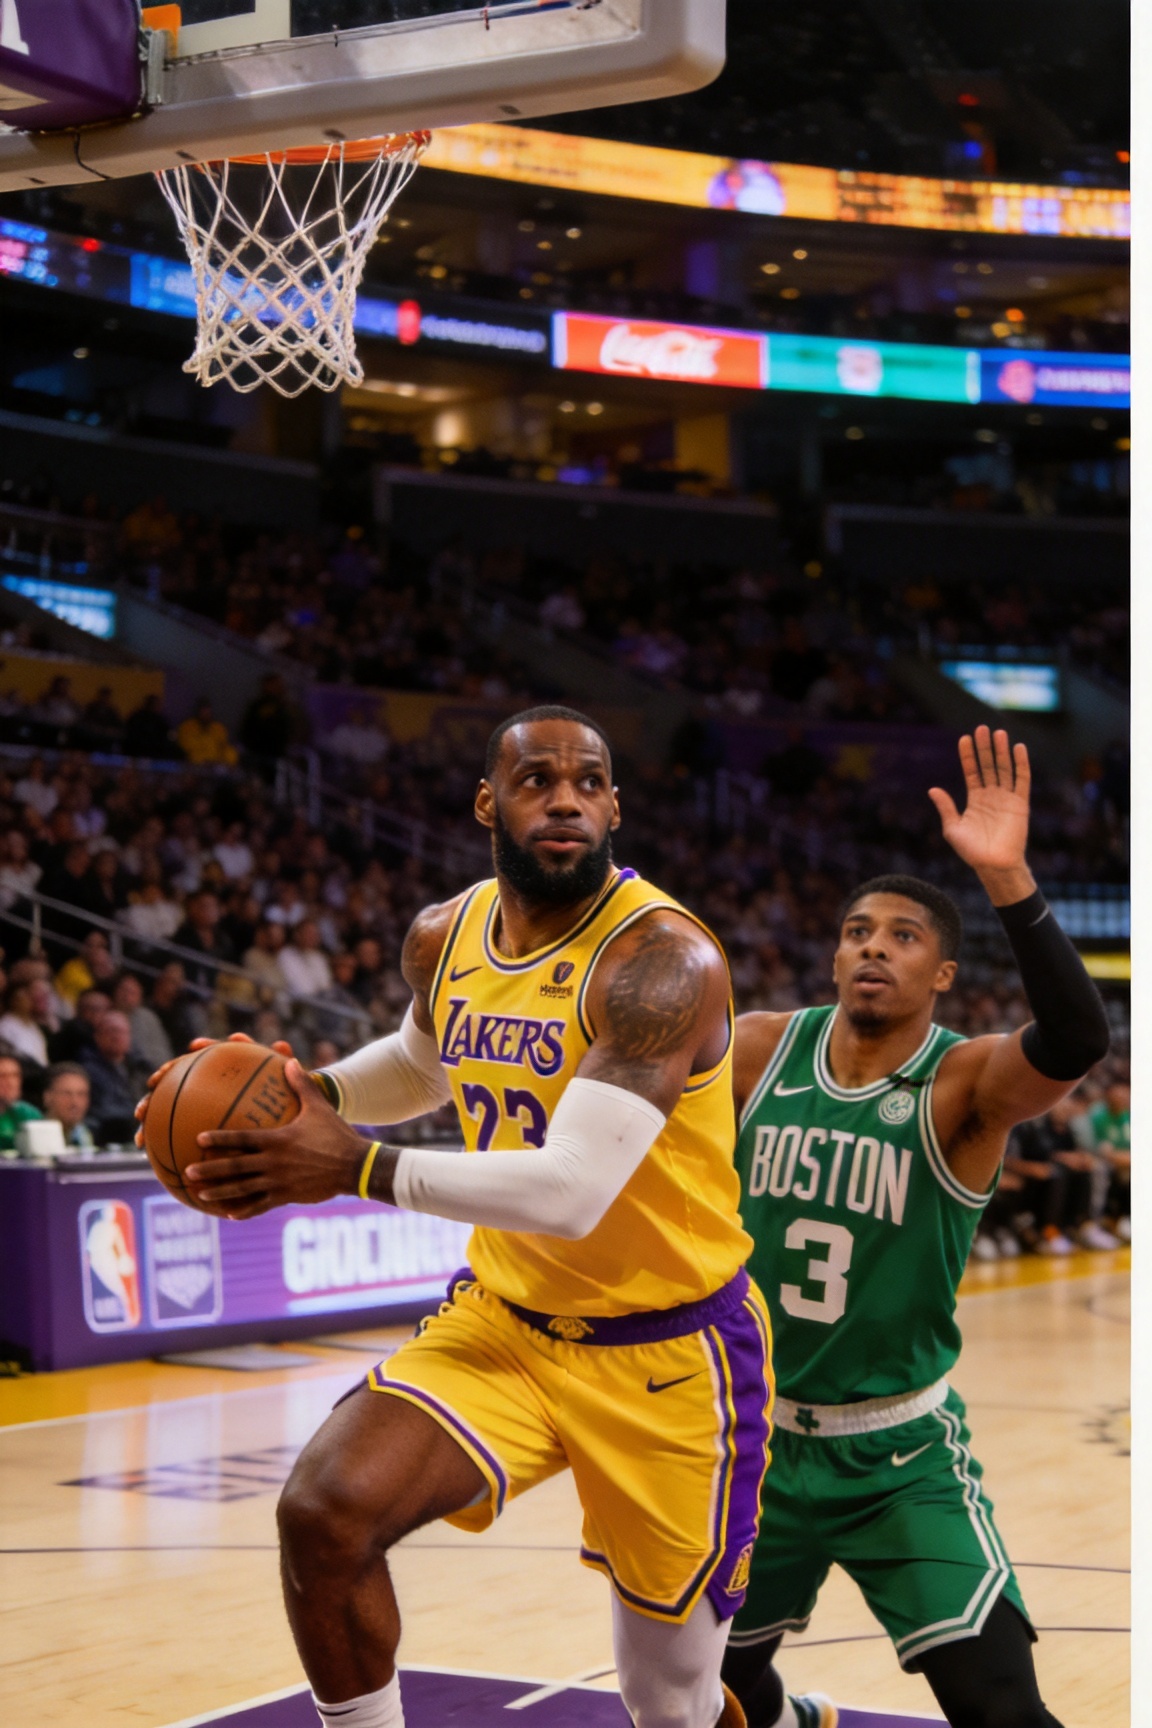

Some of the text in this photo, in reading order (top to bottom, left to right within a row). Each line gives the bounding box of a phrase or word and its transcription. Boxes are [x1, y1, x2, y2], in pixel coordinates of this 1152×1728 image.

[440, 996, 566, 1078] LAKERS
[461, 1082, 548, 1152] 23
[748, 1124, 914, 1226] BOSTON
[779, 1217, 855, 1325] 3
